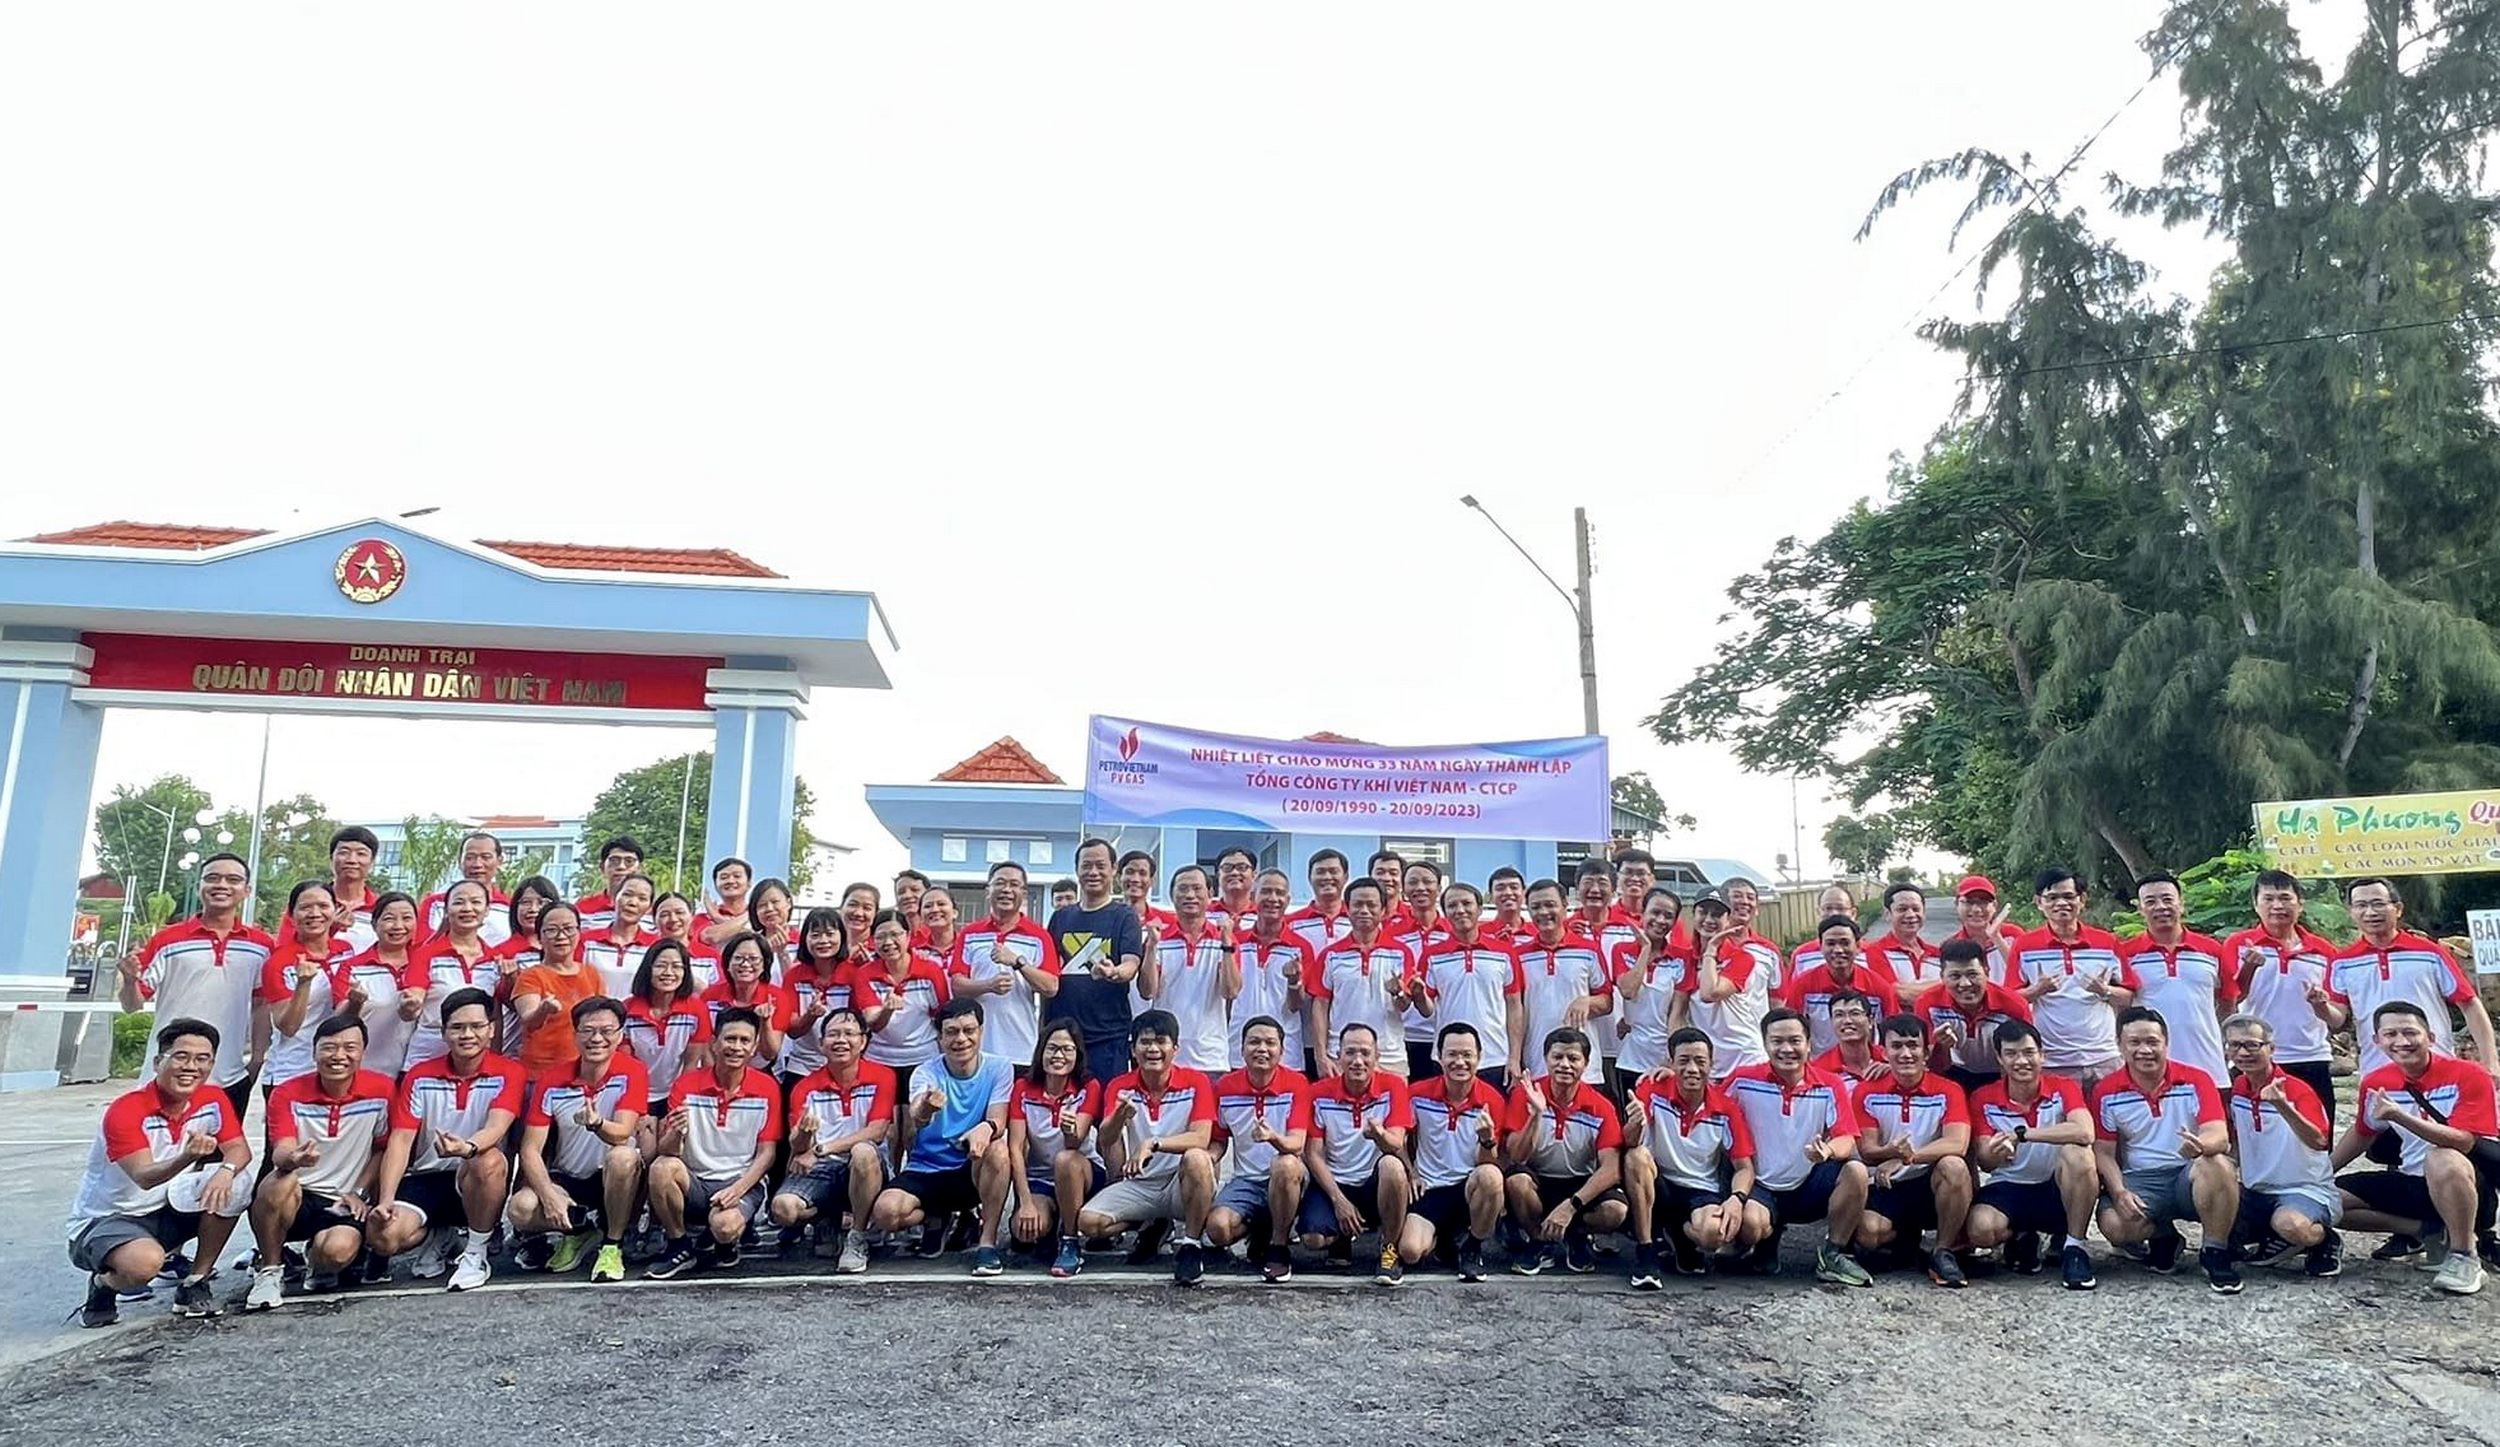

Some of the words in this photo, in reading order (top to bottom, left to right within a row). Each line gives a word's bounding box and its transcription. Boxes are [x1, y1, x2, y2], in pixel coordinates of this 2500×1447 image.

[350, 646, 420, 663] DOANH
[429, 649, 476, 668] TRẠI
[192, 660, 270, 691] QUÂN
[334, 666, 415, 697] NHÂN
[422, 668, 482, 699] DÂN
[561, 679, 627, 704] NAM
[1190, 748, 1238, 766] NHIỆT
[1378, 759, 1397, 770] 33
[1246, 768, 1289, 788] TỔNG
[1294, 773, 1338, 790] CÔNG
[1341, 778, 1361, 790] TY
[1364, 776, 1392, 792] KHÍ
[1431, 780, 1467, 794] NAM
[1479, 781, 1518, 795] CTCP
[1389, 802, 1481, 820] 20/09/2023)
